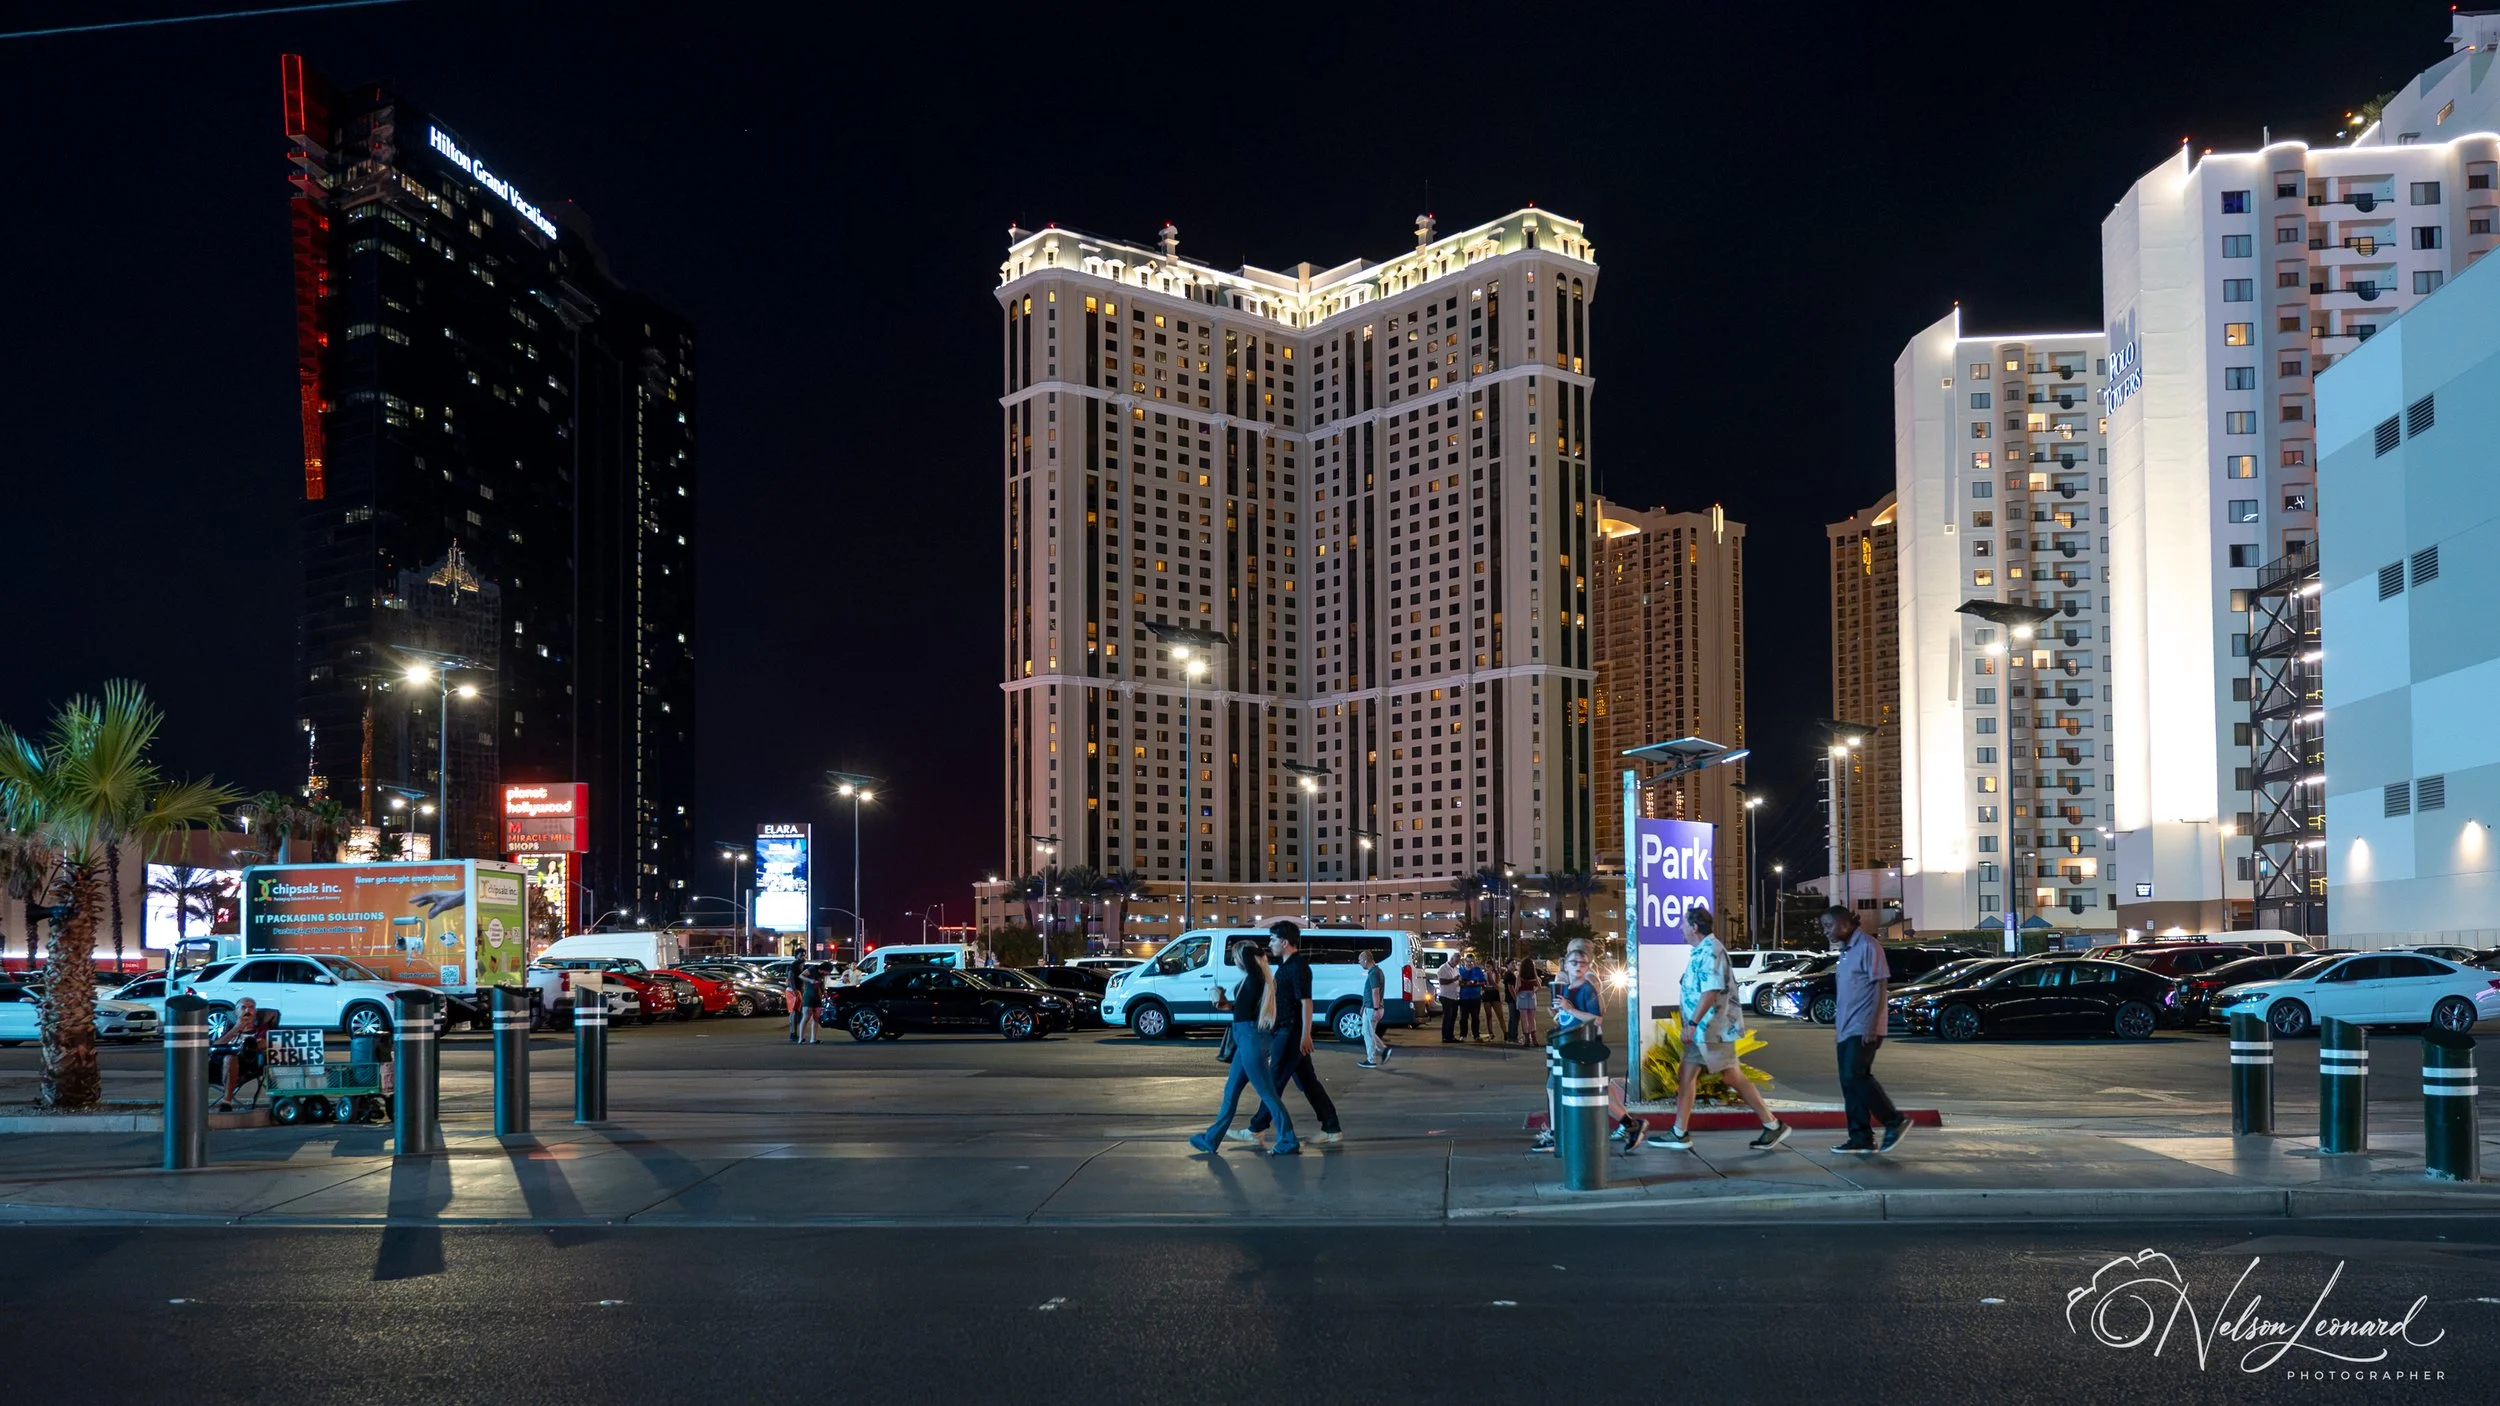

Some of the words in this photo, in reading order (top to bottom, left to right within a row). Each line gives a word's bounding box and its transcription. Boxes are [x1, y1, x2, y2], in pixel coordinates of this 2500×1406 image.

[430, 126, 471, 173] Hilton
[473, 159, 508, 201] Grand
[509, 185, 557, 240] Vacations
[2109, 341, 2136, 383] POLO
[2104, 367, 2142, 417] TOWERS
[506, 786, 548, 801] planet
[507, 800, 572, 816] hollywood
[508, 821, 521, 833] M
[765, 825, 798, 834] ELARA
[508, 834, 548, 842] MIRACLE
[551, 833, 571, 841] MILE
[508, 842, 540, 851] SHOPS
[1641, 833, 1709, 880] Park
[355, 876, 374, 884] Never
[376, 876, 387, 885] get
[388, 875, 410, 884] caught
[272, 882, 318, 896] chipsalz
[322, 882, 342, 892] inc.
[255, 915, 264, 924] IT
[267, 914, 324, 923] PACKAGING
[328, 912, 384, 922] SOLUTIONS
[268, 1030, 321, 1048] FREE
[268, 1047, 324, 1066] BIBLES
